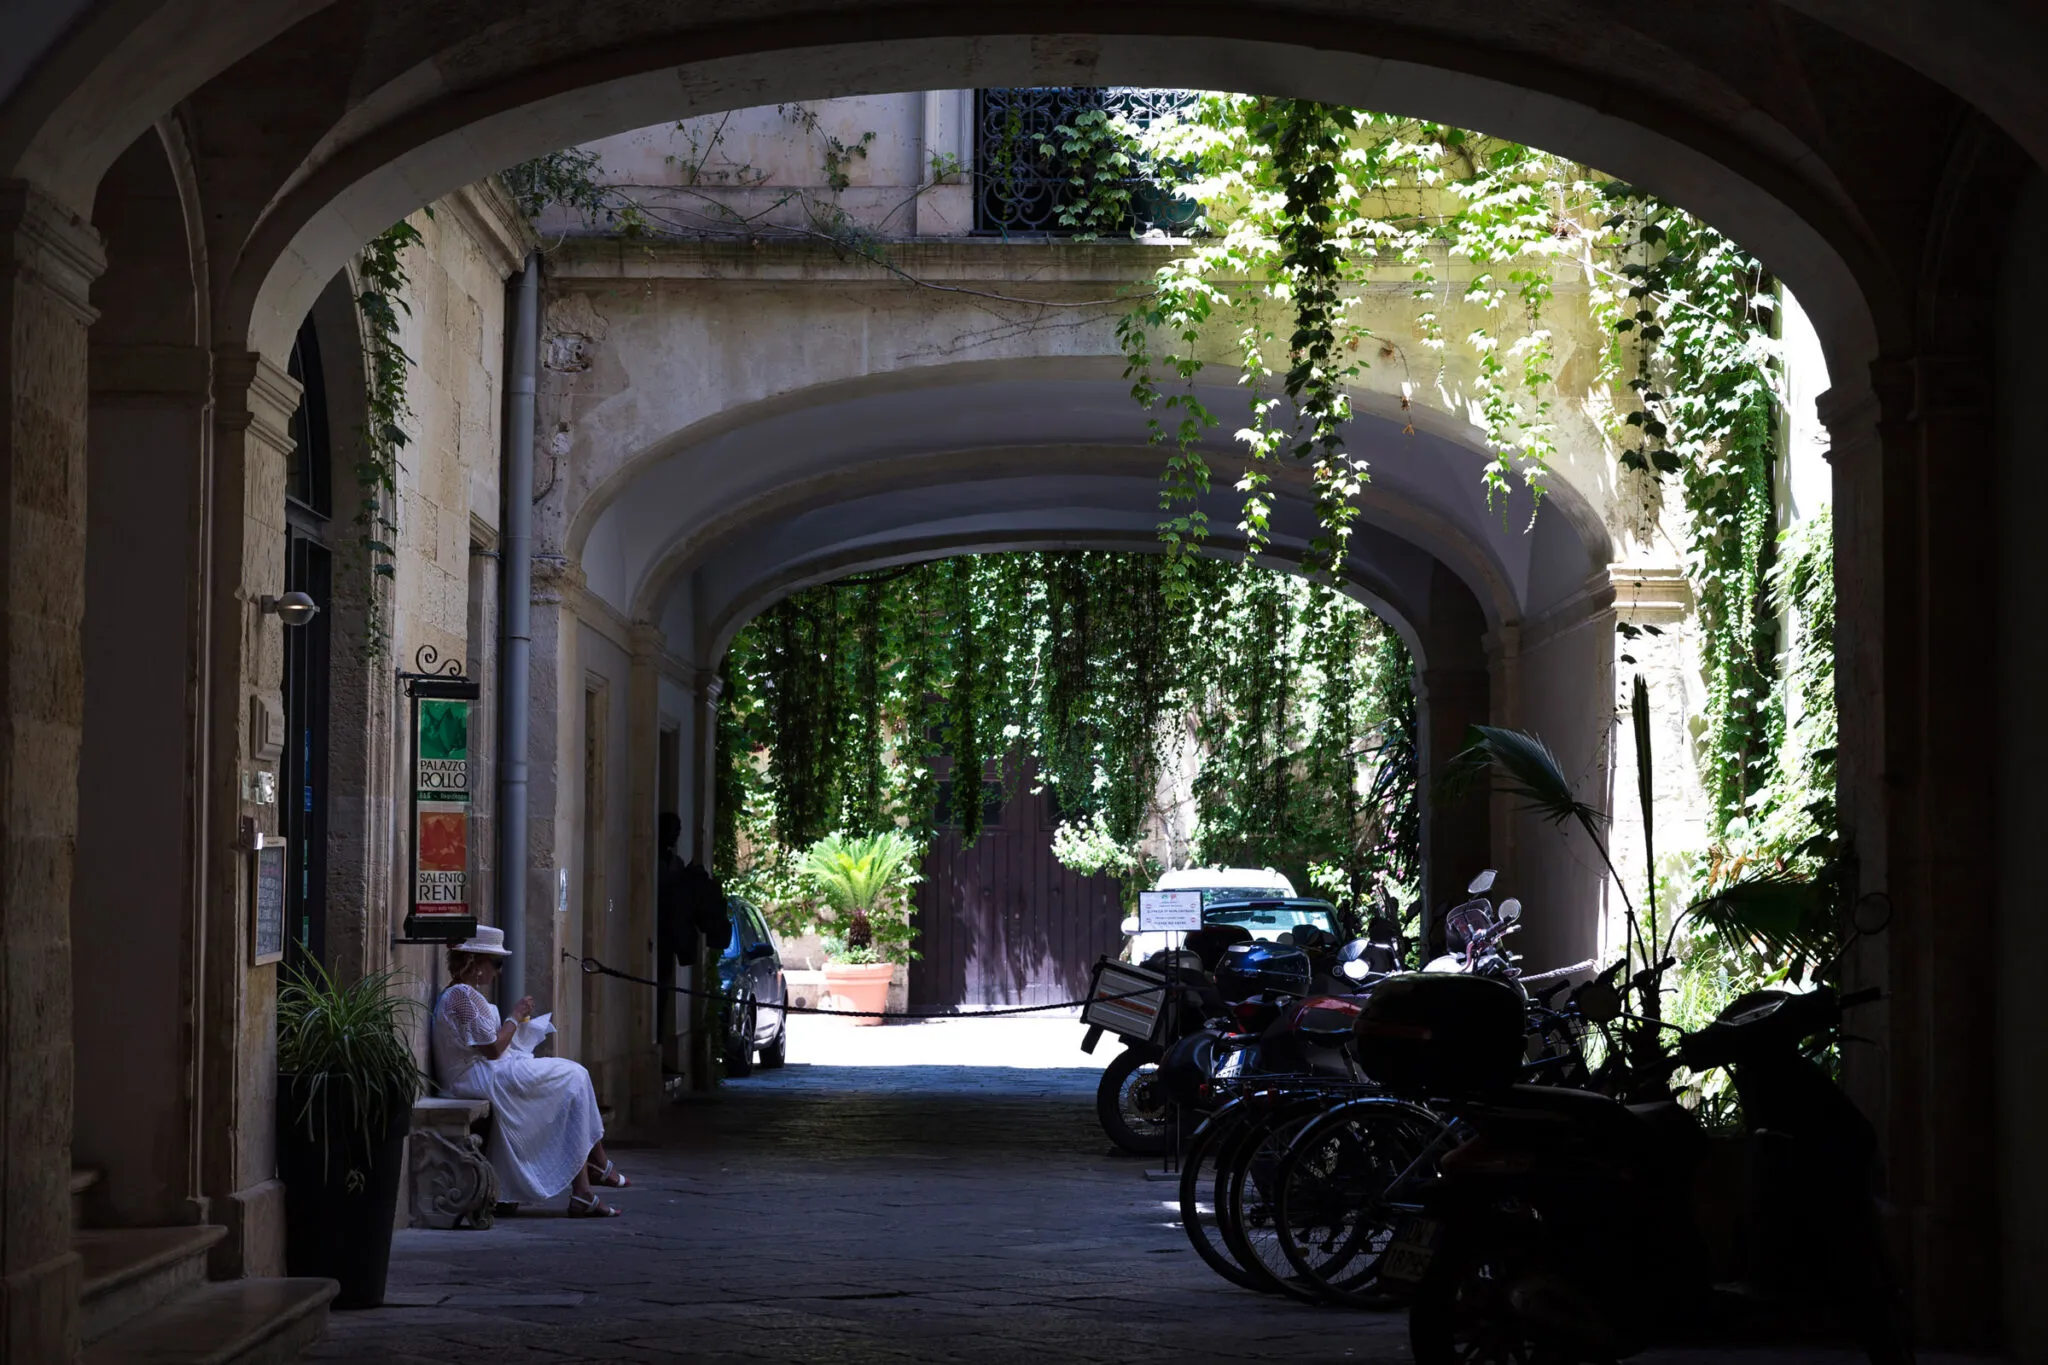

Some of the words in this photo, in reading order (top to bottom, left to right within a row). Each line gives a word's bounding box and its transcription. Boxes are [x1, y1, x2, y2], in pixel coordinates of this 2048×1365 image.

[421, 760, 467, 771] PALAZZO
[421, 772, 467, 788] ROLLO
[420, 872, 467, 884] SALENTO
[420, 884, 466, 900] RENT
